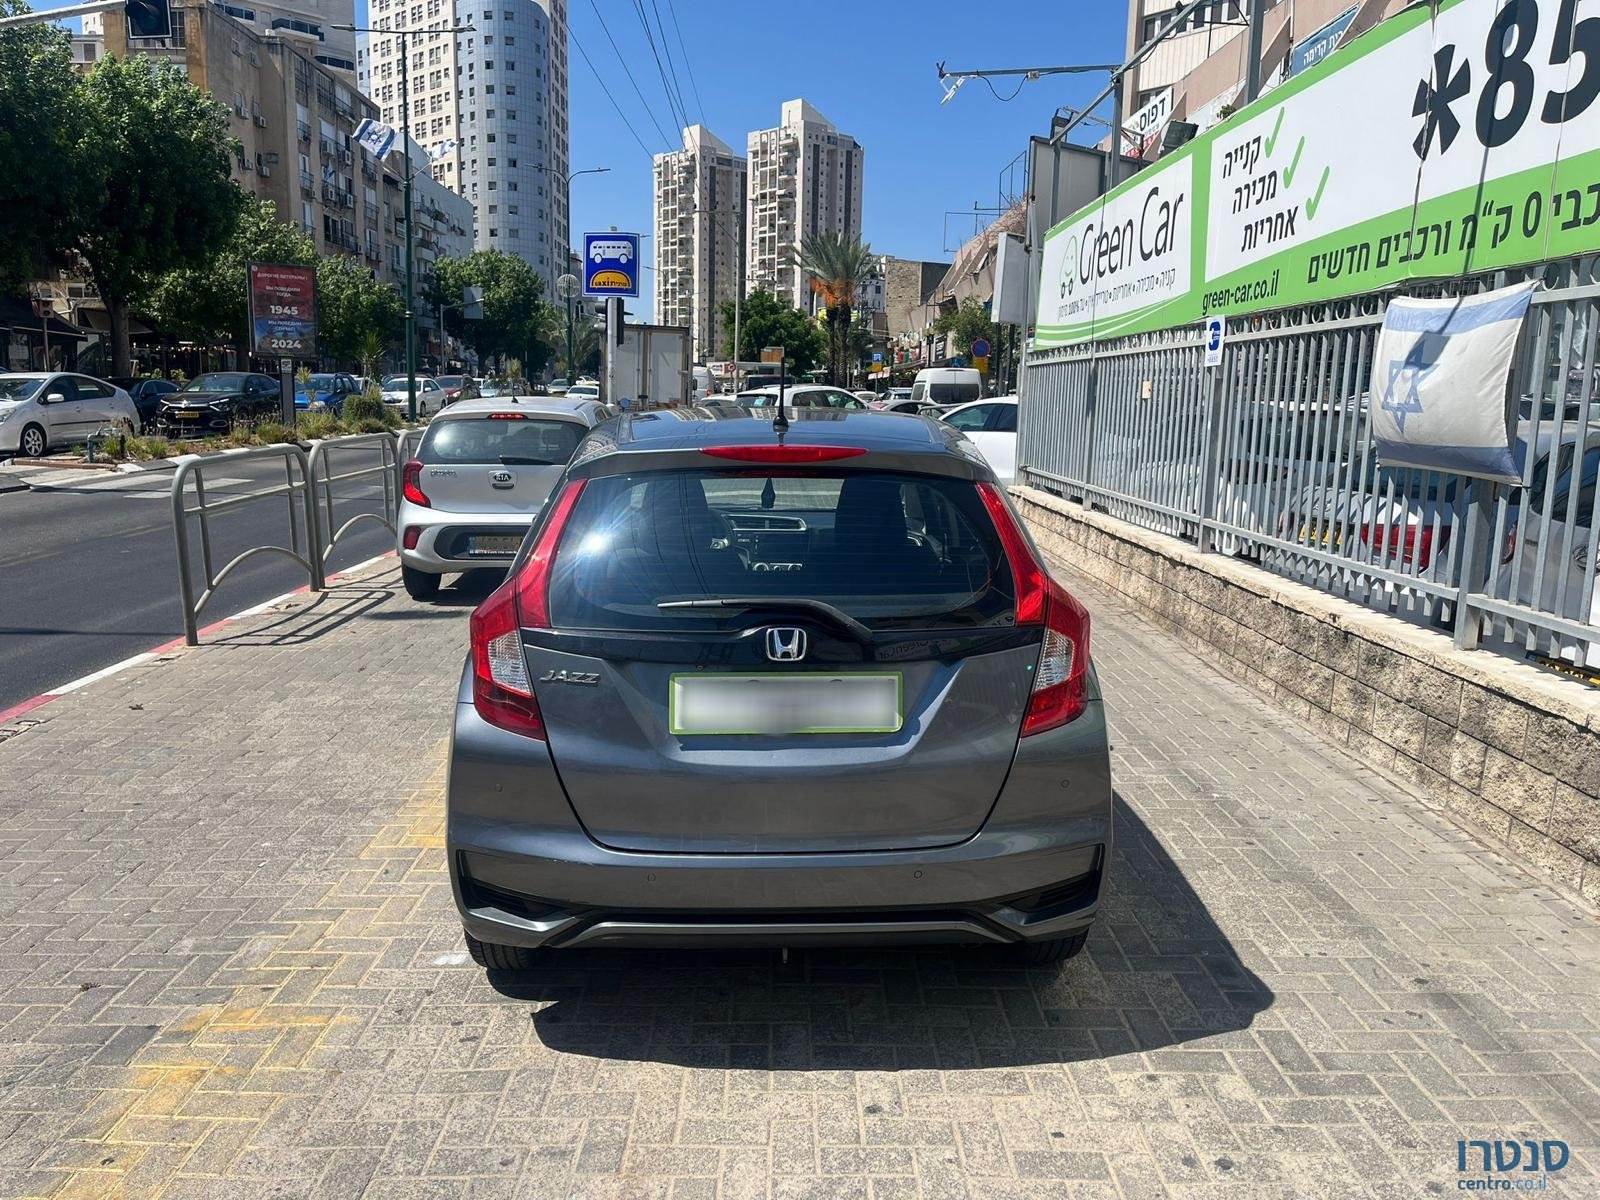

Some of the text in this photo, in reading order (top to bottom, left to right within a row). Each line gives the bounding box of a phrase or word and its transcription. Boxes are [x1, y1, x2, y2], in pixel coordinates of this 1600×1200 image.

[1303, 30, 1343, 66] ית קדימה
[1140, 97, 1166, 131] דפוס
[1222, 135, 1262, 179] קנייה
[1232, 170, 1277, 215] מכירה
[1522, 190, 1542, 238] 0
[1080, 186, 1184, 285] Green Car
[1241, 205, 1299, 252] אחריות
[1376, 220, 1451, 269] ורכבים
[1307, 242, 1370, 284] חדשים
[269, 305, 298, 315] 1945
[1202, 269, 1280, 316] green-car.co.il
[271, 339, 302, 349] 2024
[495, 473, 509, 481] KIA
[539, 669, 600, 684] JAZZ
